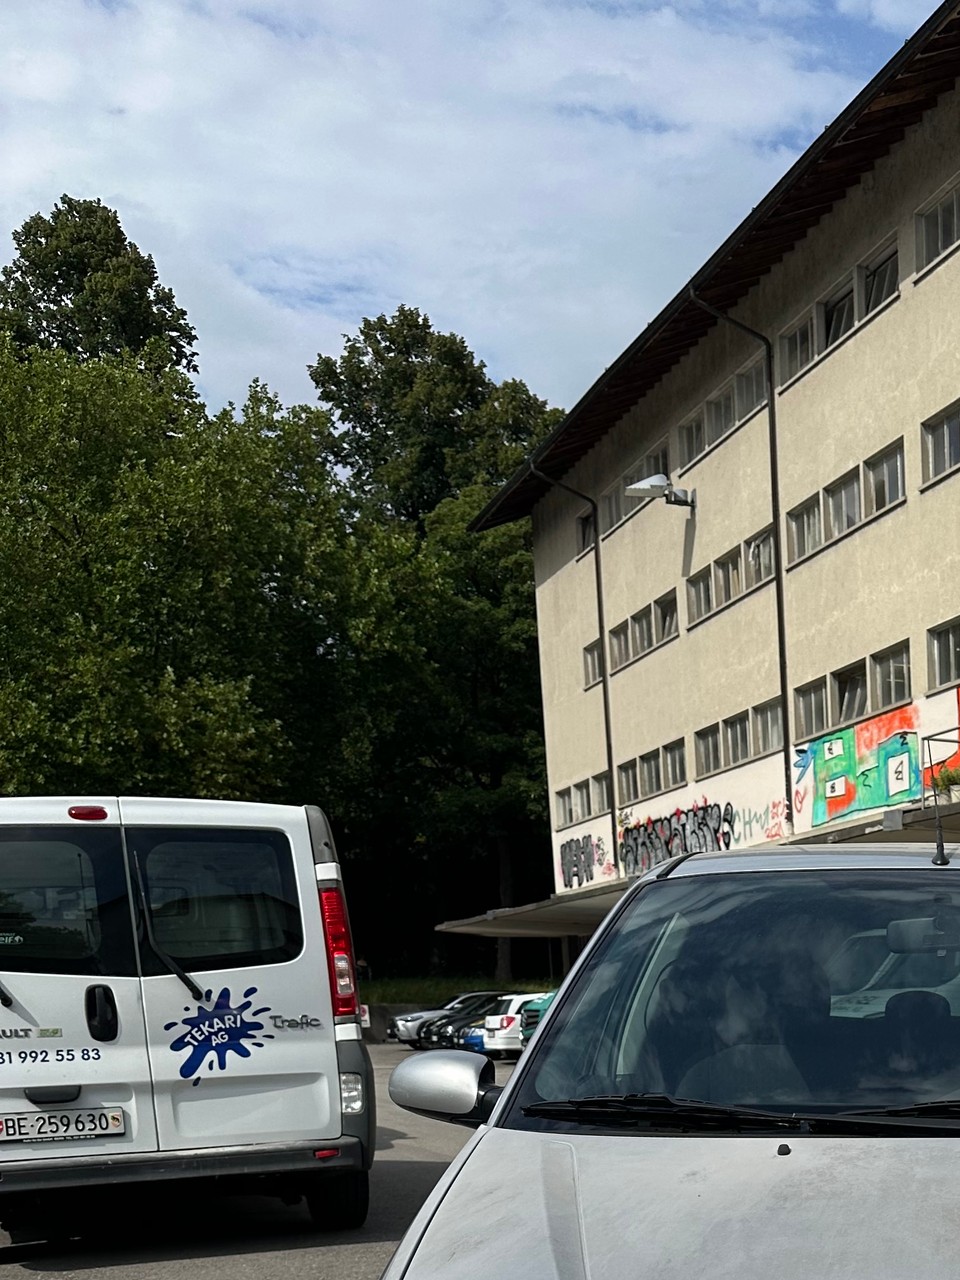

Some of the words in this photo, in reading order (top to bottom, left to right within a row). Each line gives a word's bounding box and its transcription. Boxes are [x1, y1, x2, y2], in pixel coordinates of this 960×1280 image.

[184, 1014, 241, 1046] TEKARI
[269, 1014, 322, 1030] Trafic
[211, 1031, 229, 1047] AG
[18, 1049, 50, 1064] 992
[55, 1049, 76, 1062] 55
[81, 1048, 102, 1061] 83
